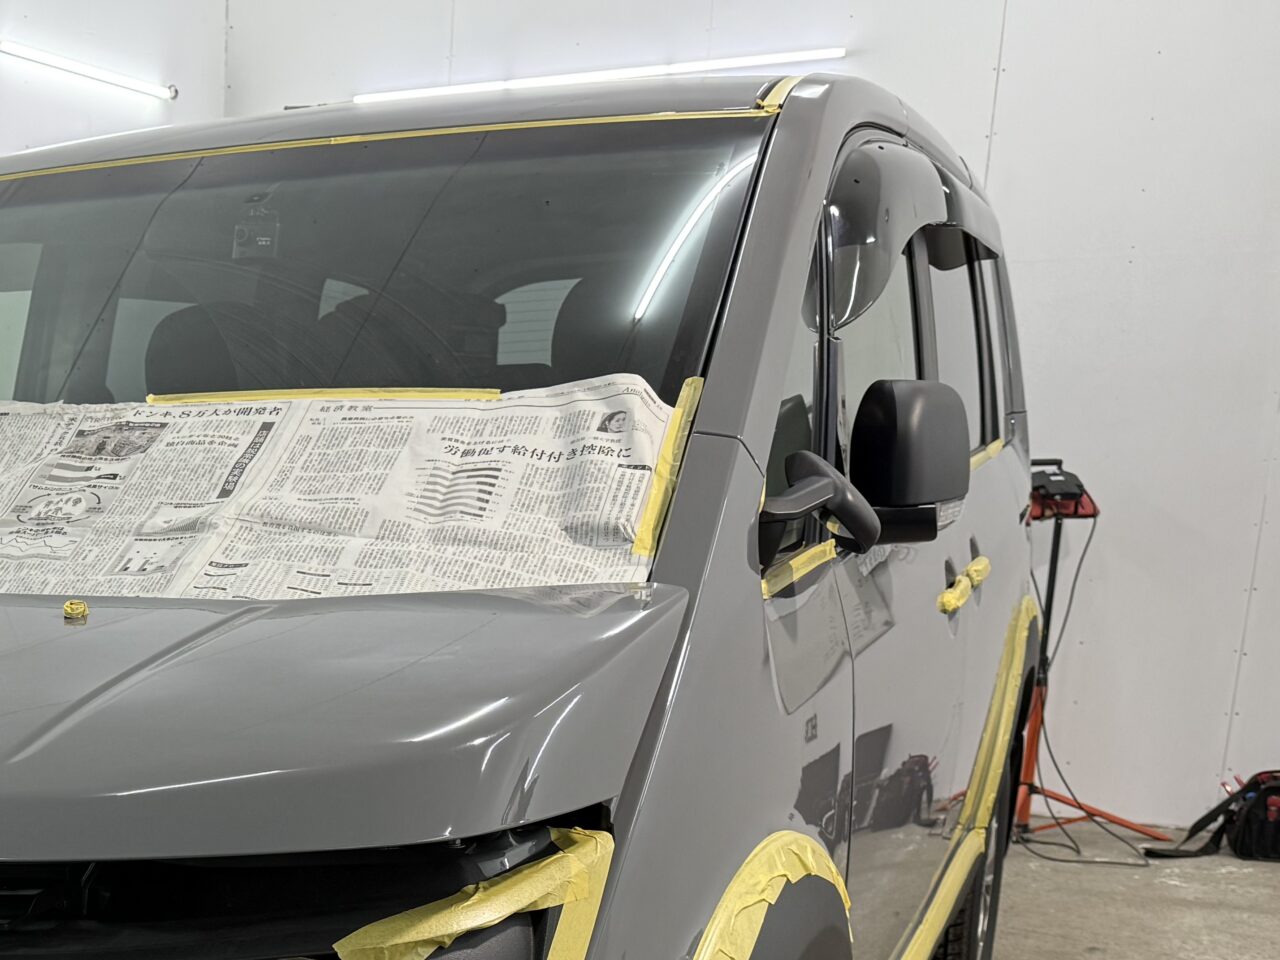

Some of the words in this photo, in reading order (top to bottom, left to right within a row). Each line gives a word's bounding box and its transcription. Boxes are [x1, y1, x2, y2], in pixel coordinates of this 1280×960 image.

[132, 406, 284, 419] ドンキ、8万人が開発者
[319, 404, 374, 413] 経済教室
[443, 443, 633, 464] 労働促す給付付き控除に
